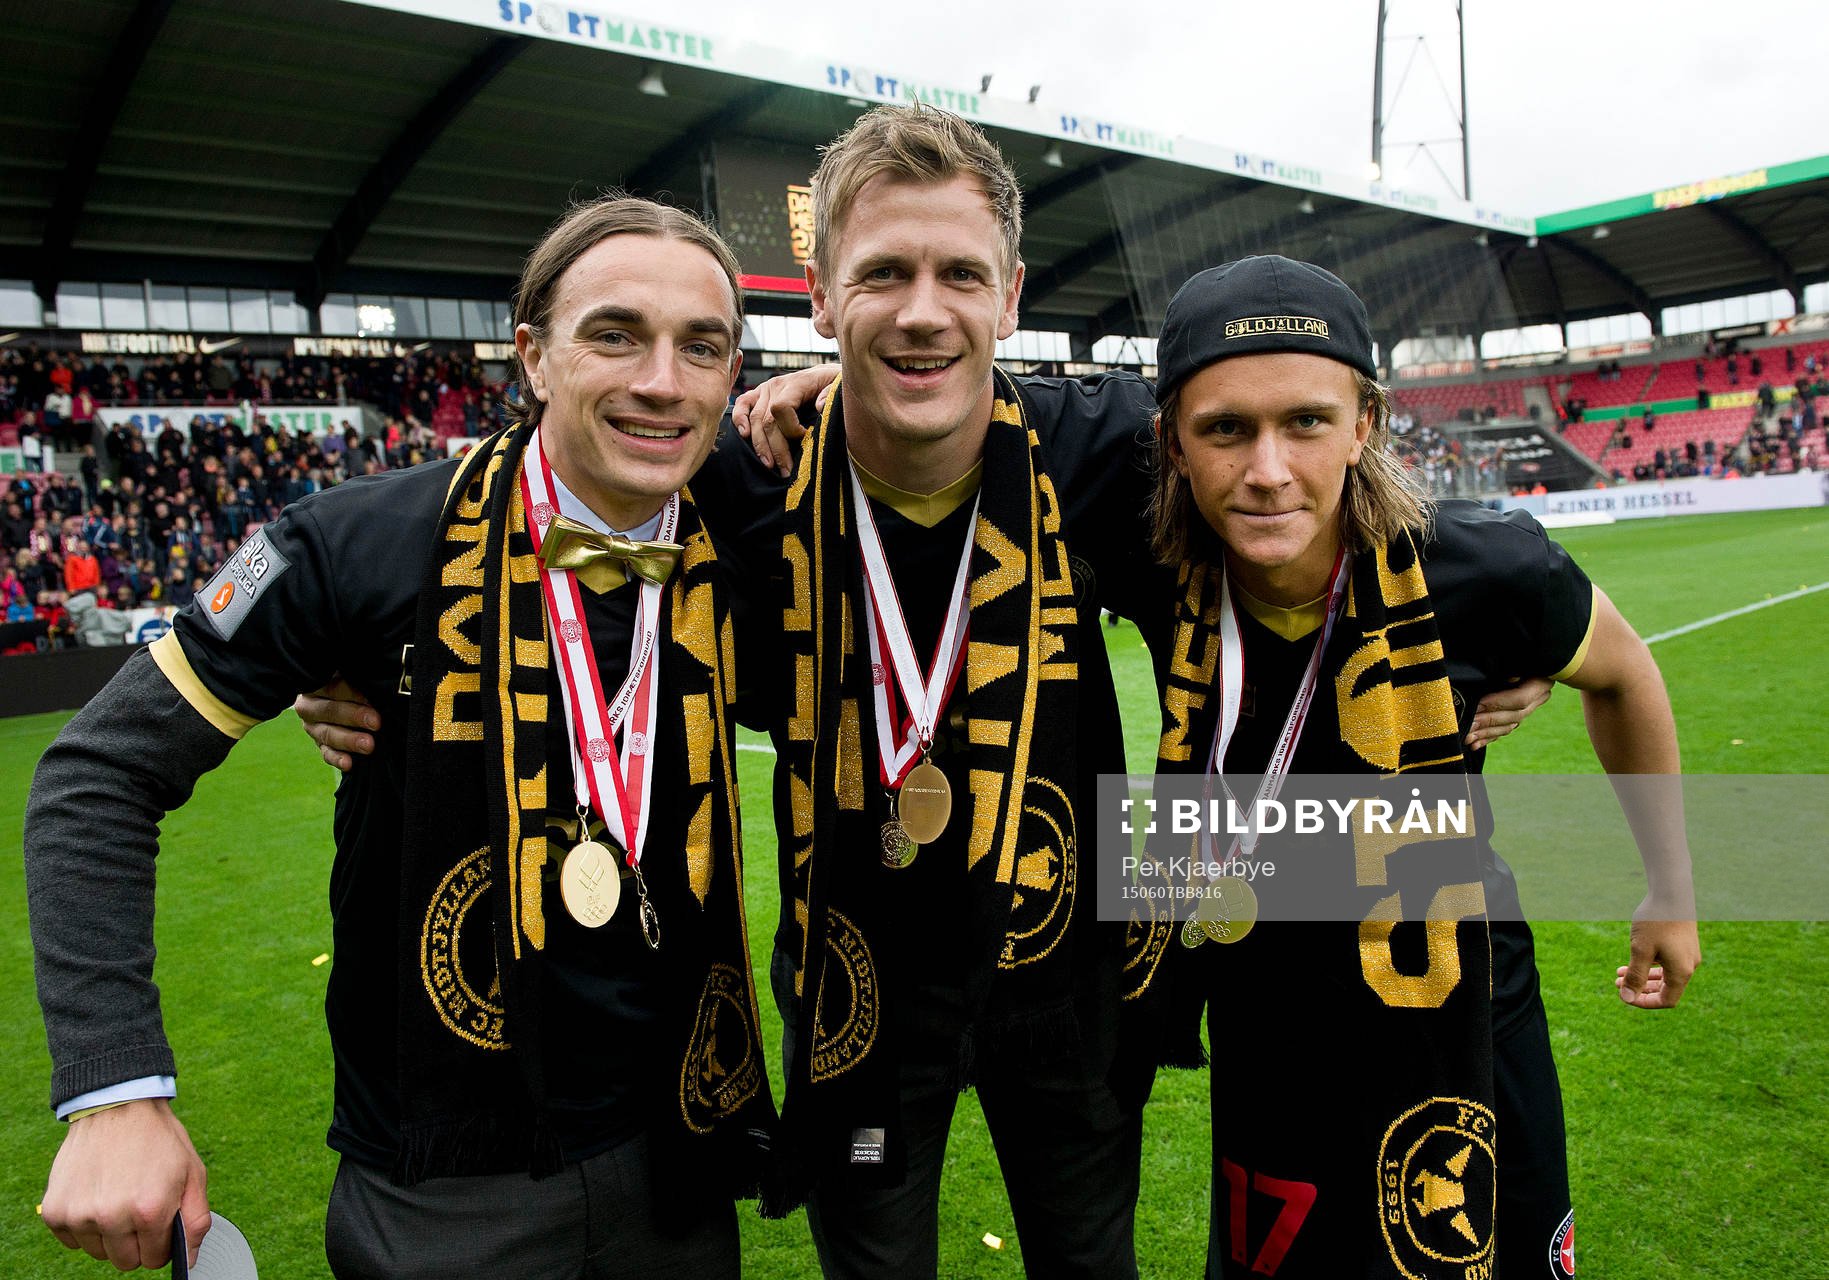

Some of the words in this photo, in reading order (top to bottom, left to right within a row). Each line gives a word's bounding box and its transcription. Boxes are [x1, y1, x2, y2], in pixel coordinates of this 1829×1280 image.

[229, 558, 256, 599] SUPERLIGA
[1222, 1157, 1318, 1277] 17
[1385, 1159, 1401, 1225] 1999
